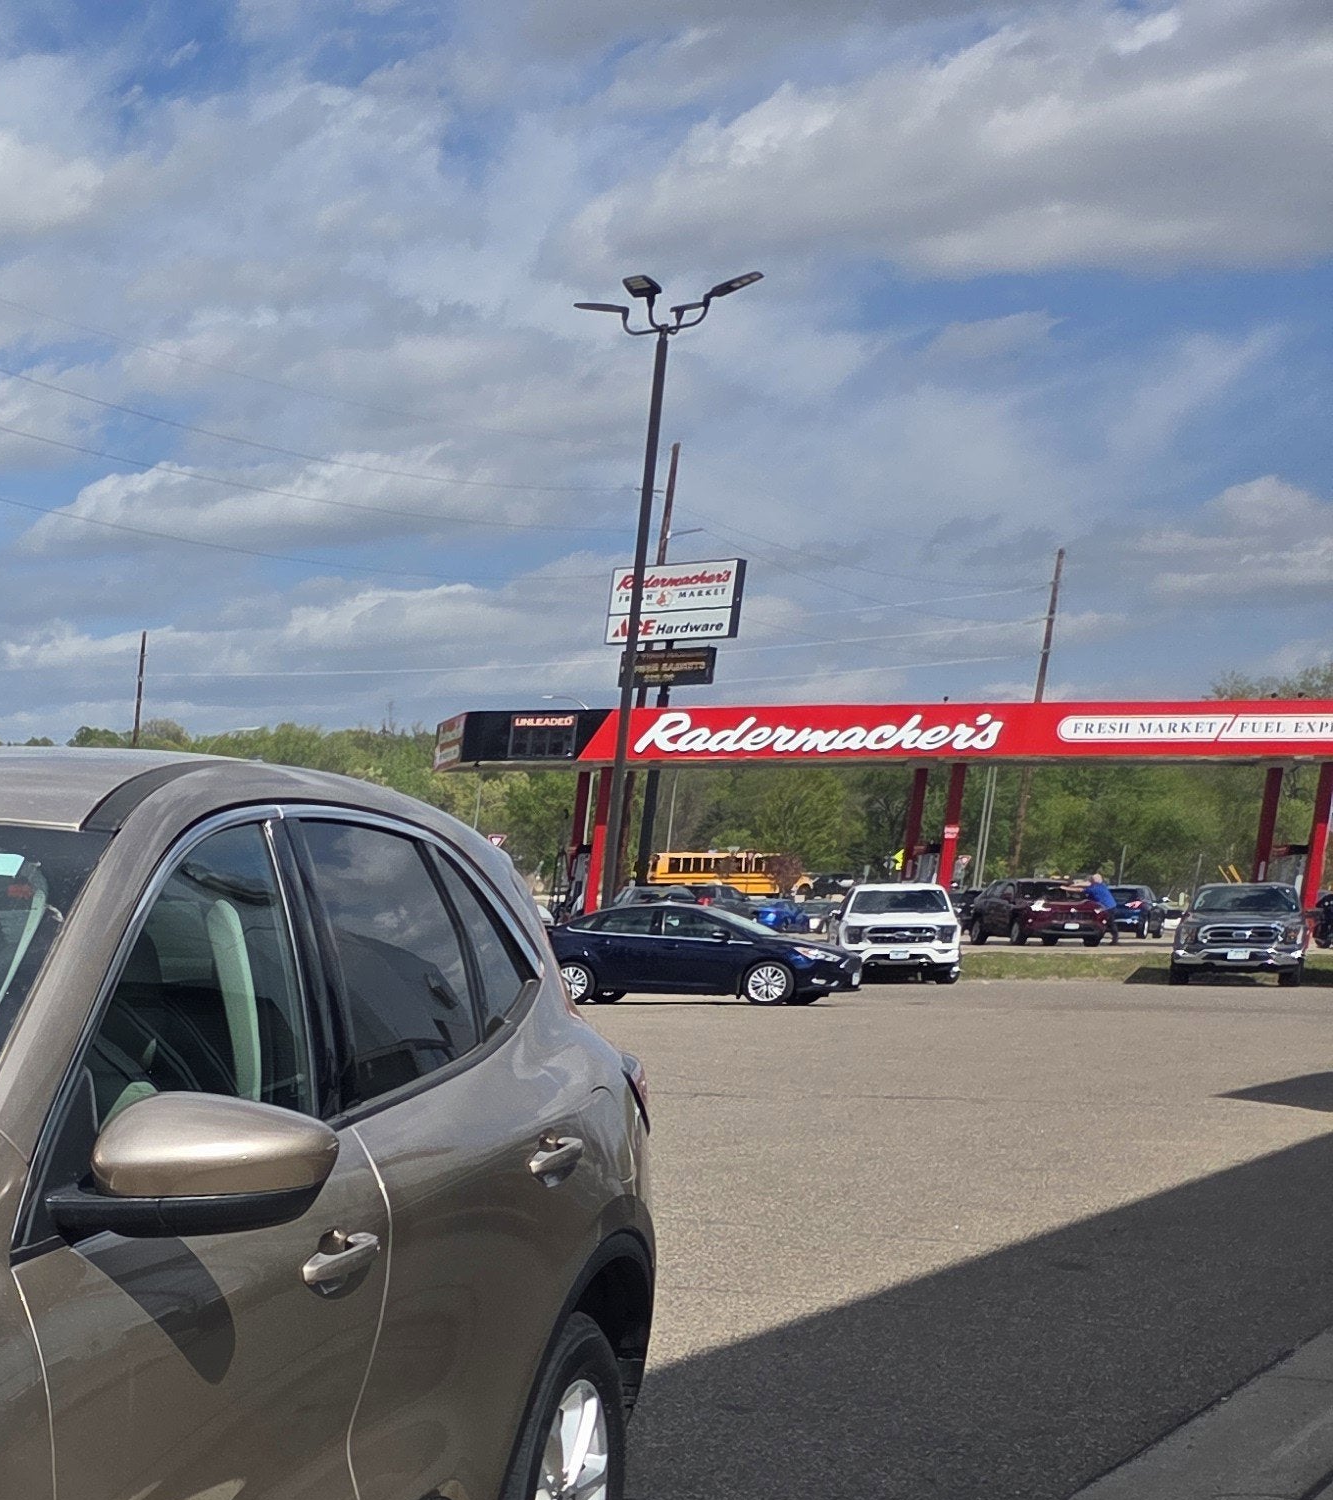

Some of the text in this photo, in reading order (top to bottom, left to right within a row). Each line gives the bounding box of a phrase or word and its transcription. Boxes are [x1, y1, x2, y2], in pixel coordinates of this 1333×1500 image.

[616, 569, 732, 591] Rdermacher's
[678, 588, 726, 599] MARKET
[655, 622, 724, 635] Hardware
[515, 716, 574, 726] UNLEADED
[1073, 721, 1333, 734] FRESH MARKET FUEL EXP
[634, 712, 1004, 753] Radermacher's
